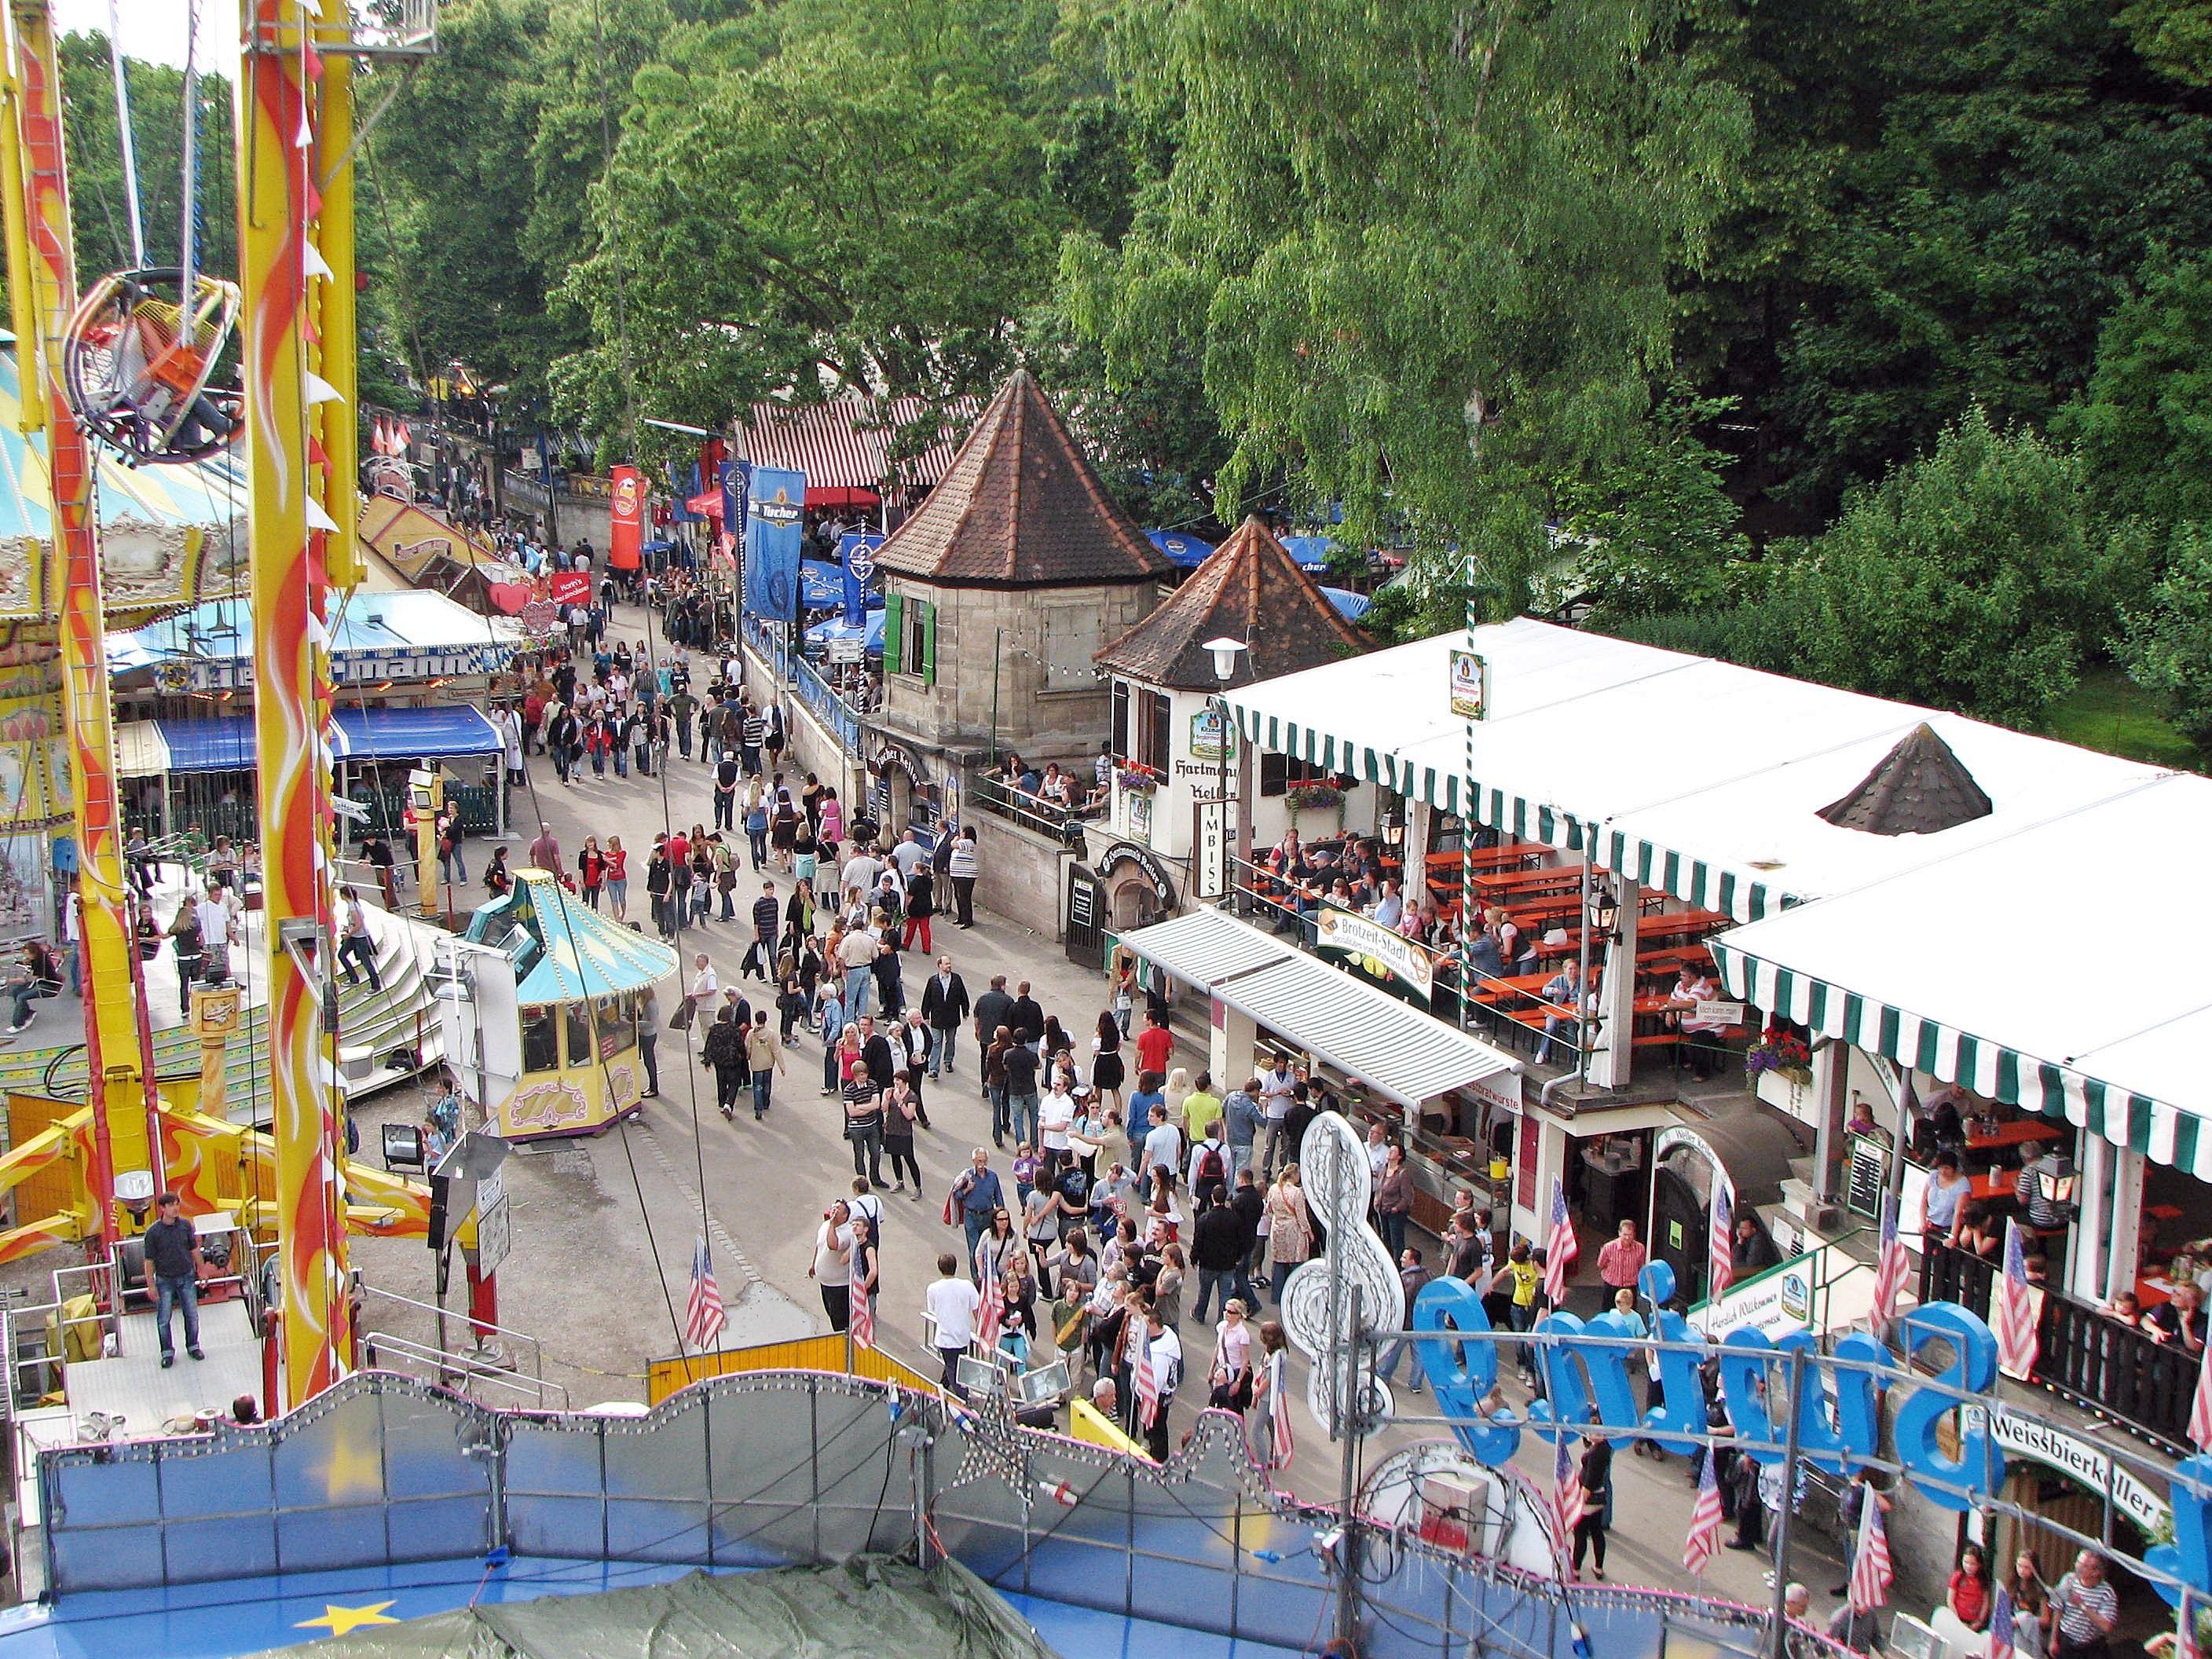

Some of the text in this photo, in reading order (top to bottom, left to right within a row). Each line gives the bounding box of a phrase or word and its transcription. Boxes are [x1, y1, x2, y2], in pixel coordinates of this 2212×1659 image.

[763, 505, 799, 519] Tucher
[1206, 805, 1218, 895] IMBISS
[1342, 918, 1406, 961] Brotzeit-Stadl
